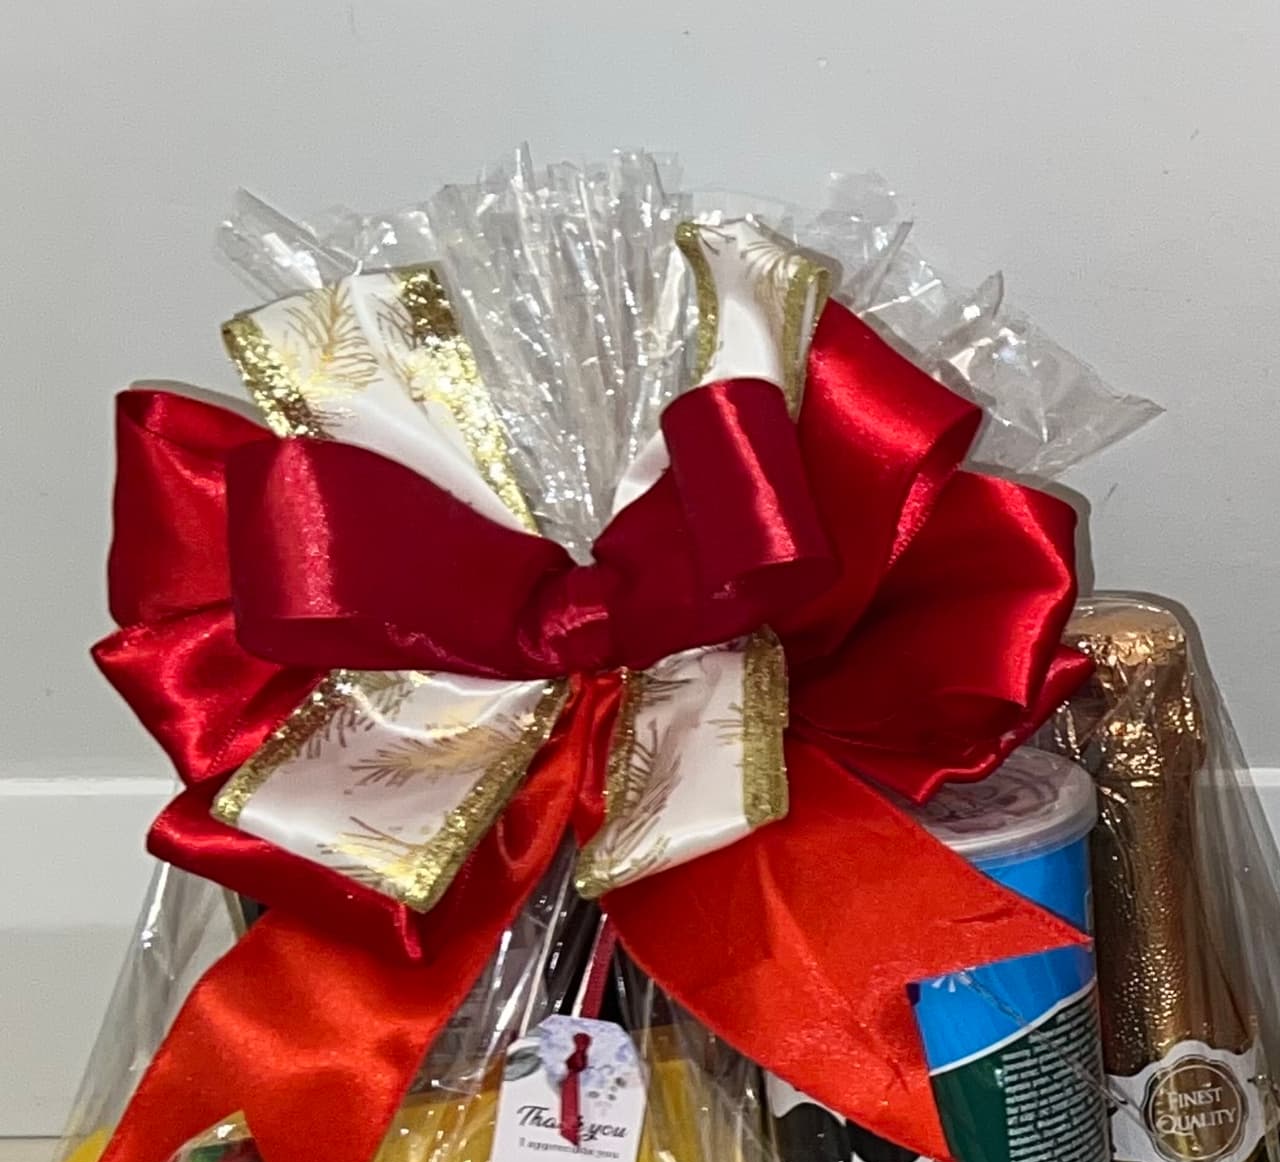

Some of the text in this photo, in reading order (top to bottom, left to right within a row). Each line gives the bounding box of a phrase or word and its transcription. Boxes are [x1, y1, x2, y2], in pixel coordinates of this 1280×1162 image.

[1167, 1086, 1223, 1112] FINEST
[516, 1104, 627, 1142] Tha you
[1156, 1107, 1237, 1136] QUALITY
